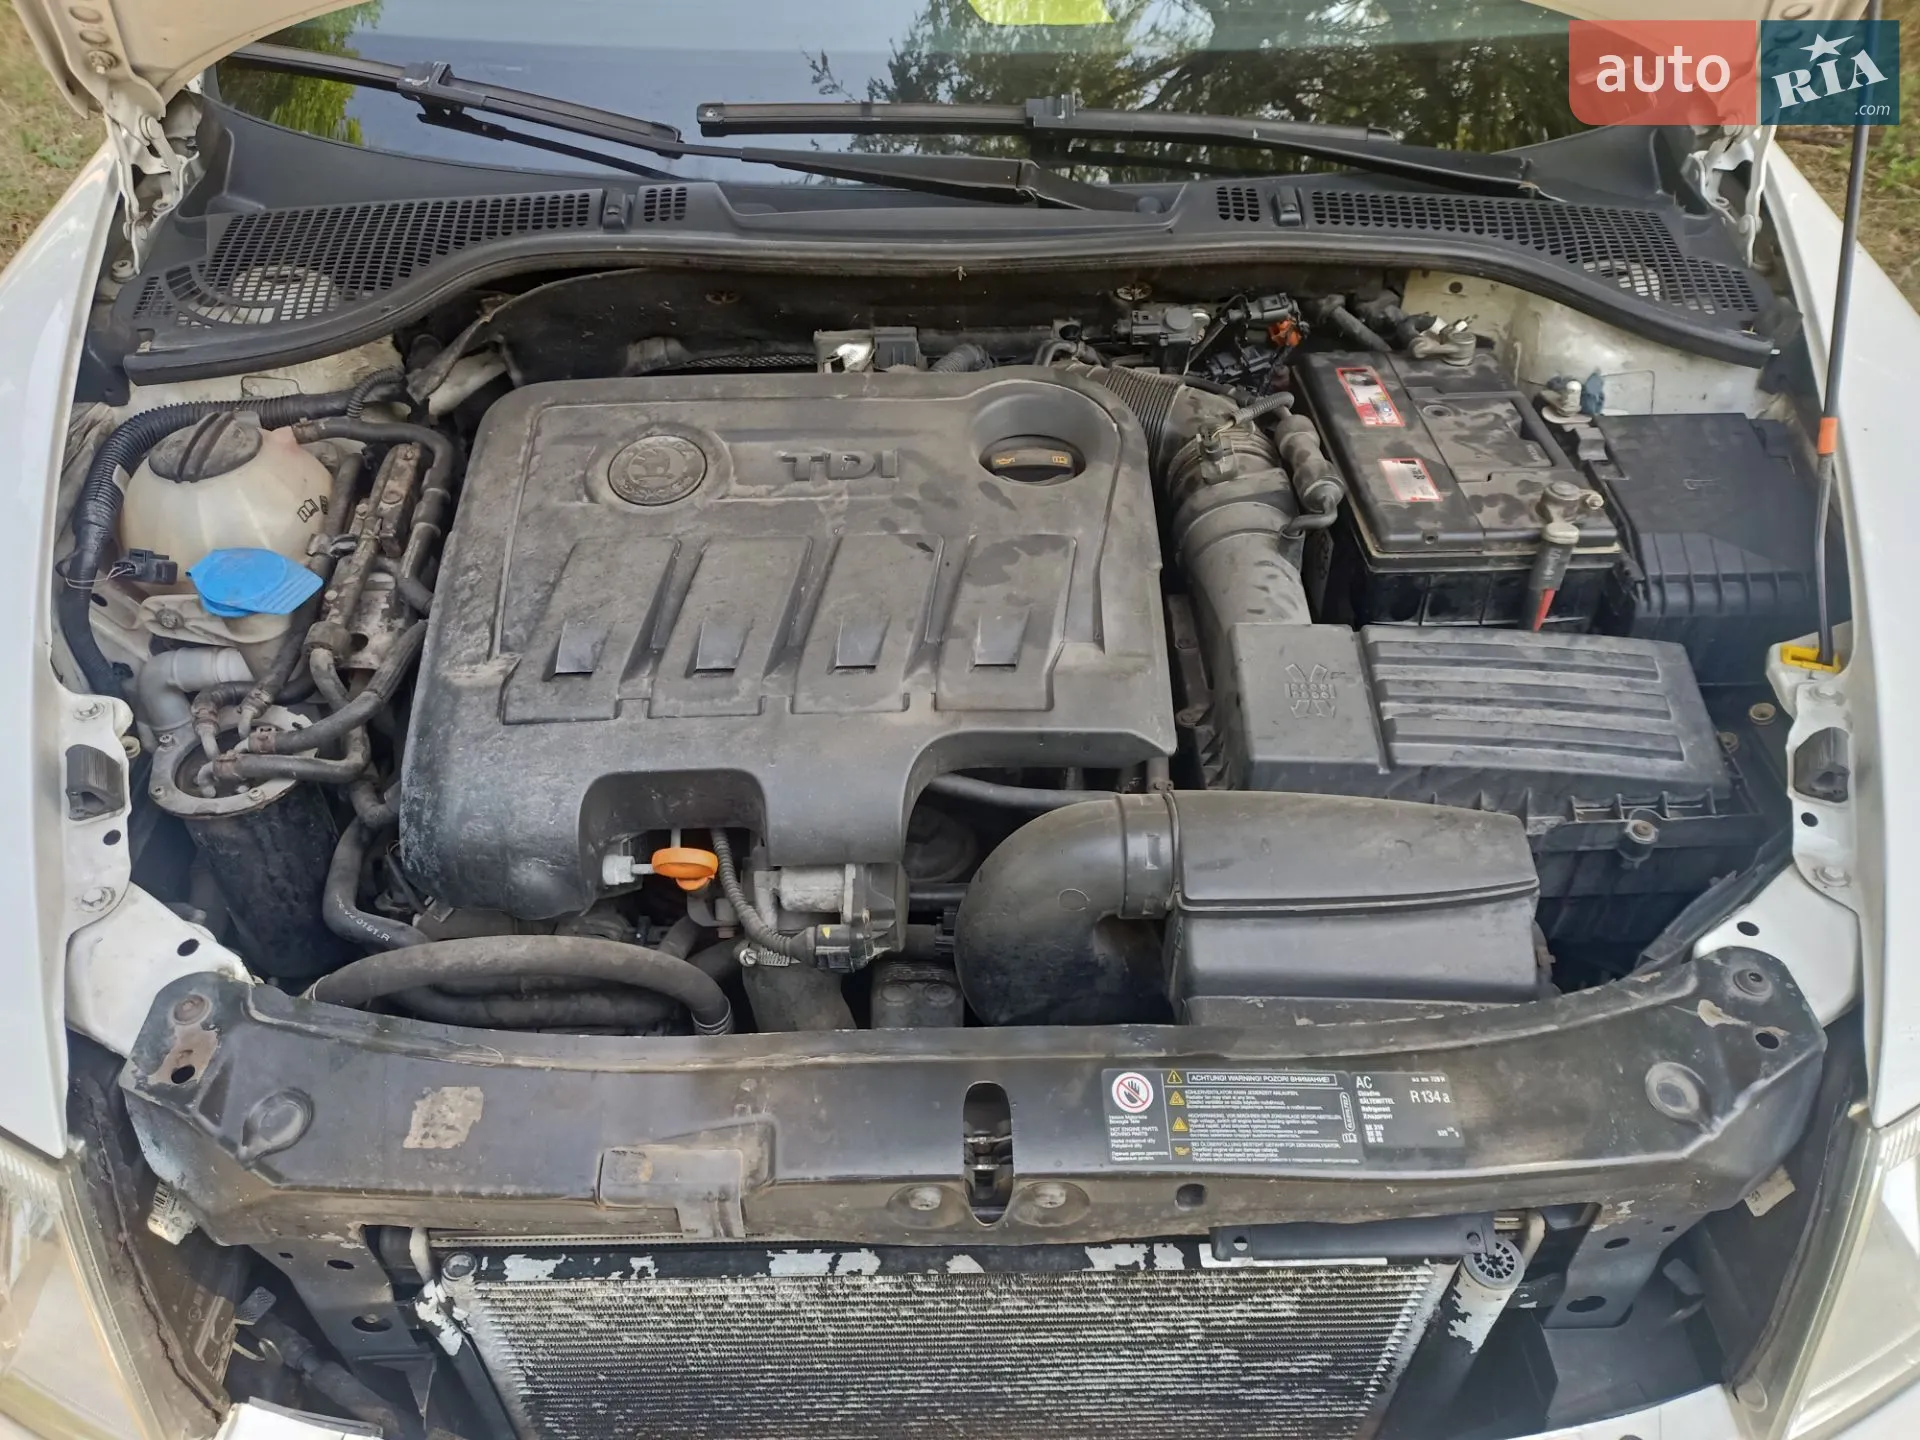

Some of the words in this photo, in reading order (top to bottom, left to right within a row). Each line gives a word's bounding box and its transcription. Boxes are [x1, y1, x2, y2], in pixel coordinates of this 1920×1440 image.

[777, 449, 900, 481] TDI
[1191, 1074, 1227, 1082] ACHTUNG!
[1356, 1075, 1373, 1089] AC
[1409, 1090, 1420, 1103] R
[1420, 1089, 1442, 1103] 134
[1442, 1091, 1451, 1104] a
